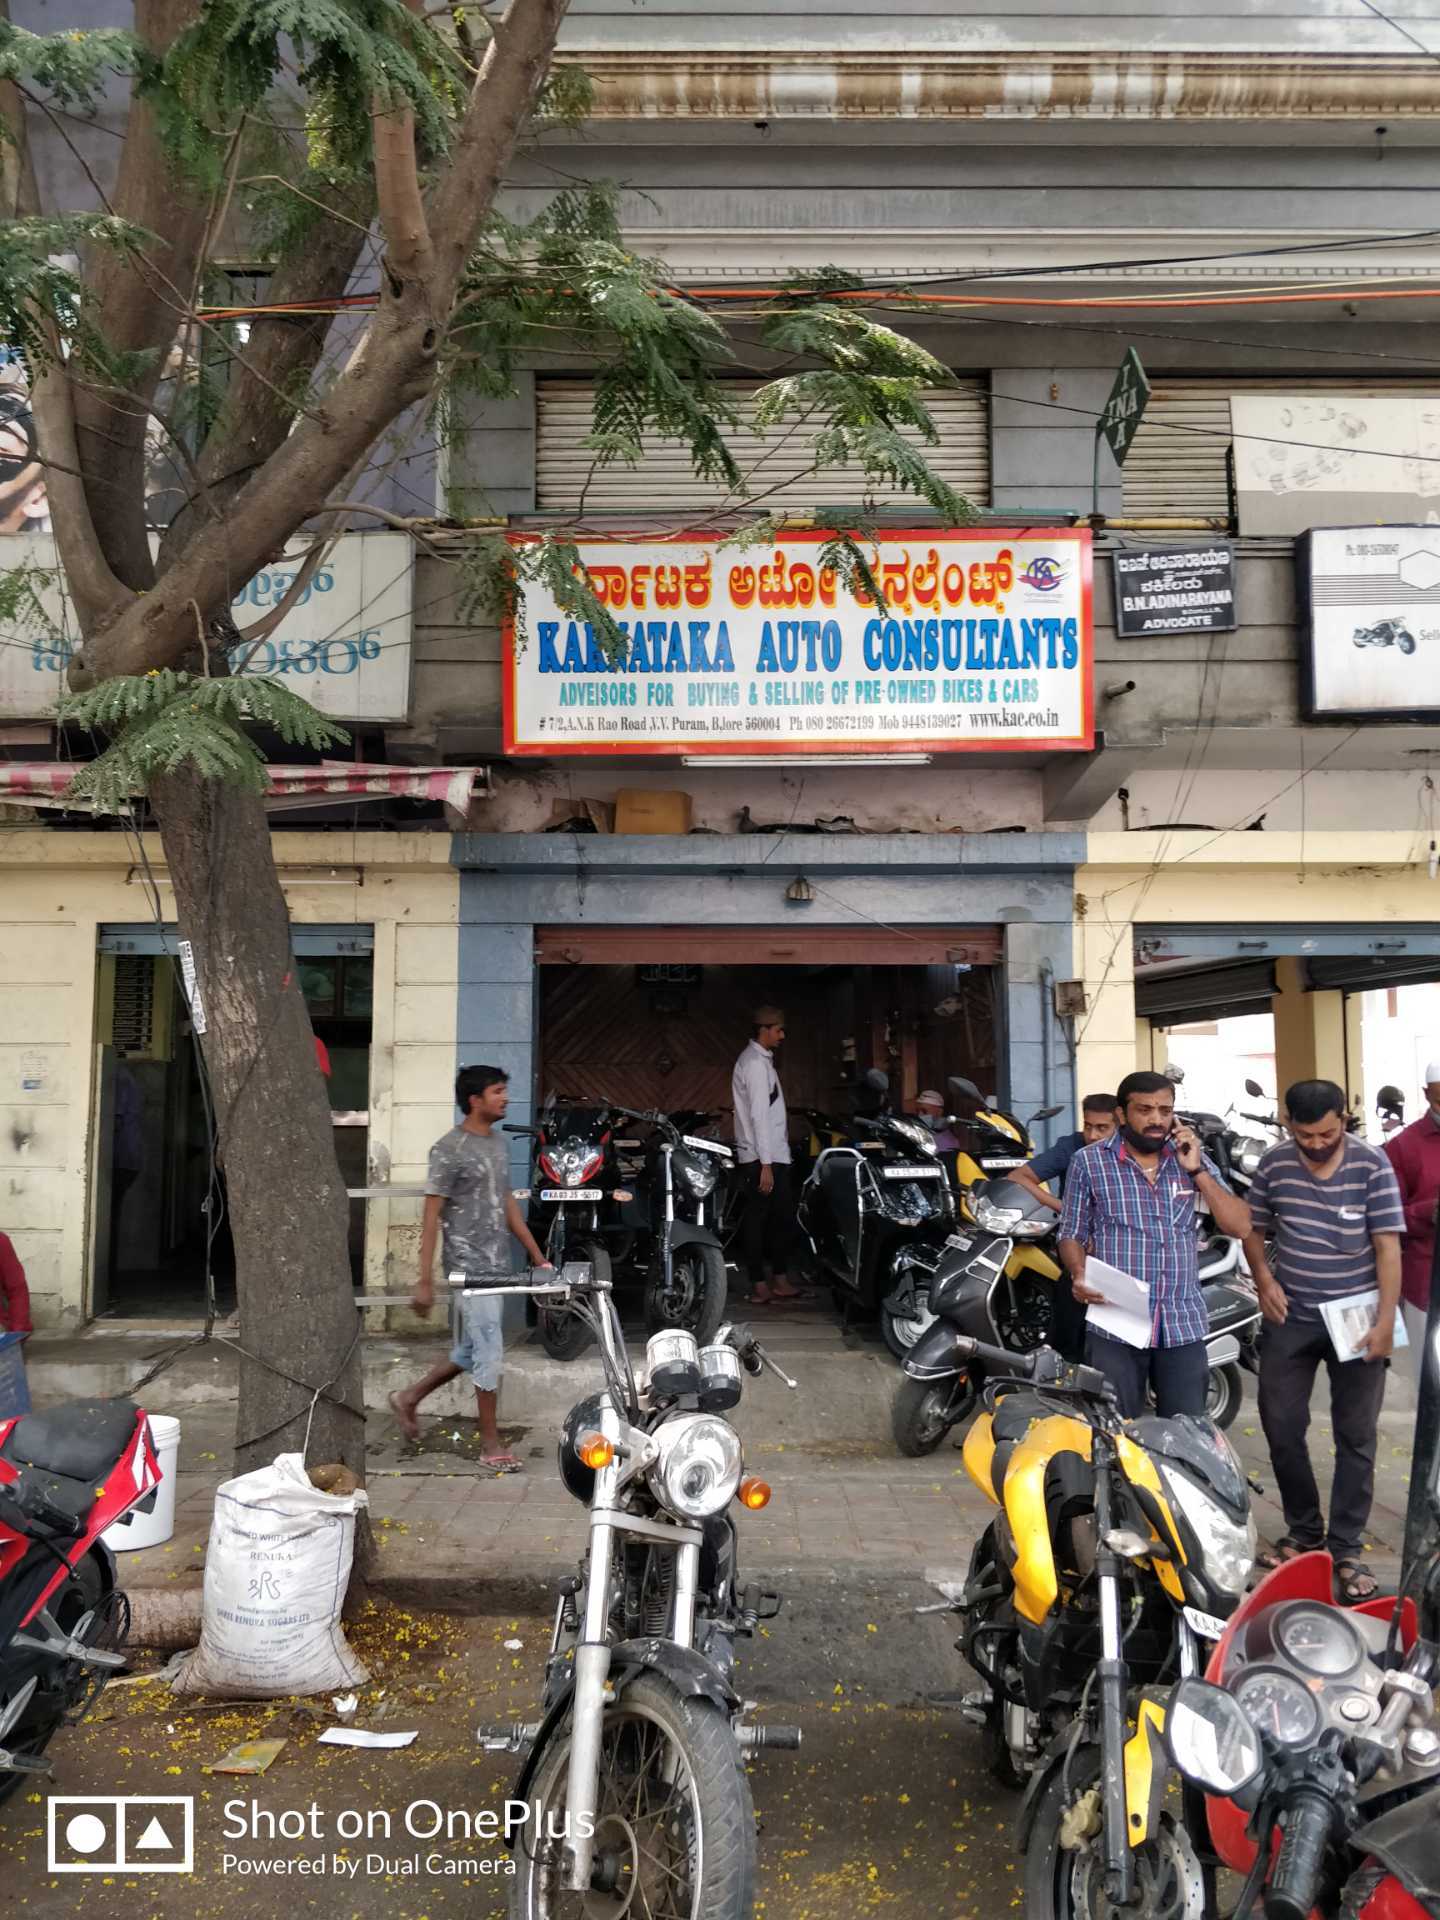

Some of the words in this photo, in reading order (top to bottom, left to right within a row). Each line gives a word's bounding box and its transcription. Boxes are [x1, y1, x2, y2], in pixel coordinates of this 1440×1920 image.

[1143, 615, 1213, 629] ADVOCATE
[756, 620, 842, 672] AUTO
[863, 618, 1078, 671] CONSULTANTS
[559, 682, 637, 706] ADVEISORS
[647, 682, 674, 706] FOR
[688, 682, 740, 706] BUYING
[749, 682, 758, 705] &
[765, 681, 824, 705] SELLING
[831, 681, 849, 704] OF
[942, 679, 983, 703] BIKES
[988, 679, 997, 703] &
[1003, 678, 1039, 703] CARS
[598, 717, 617, 731] Rao
[620, 716, 647, 731] Road
[671, 716, 709, 732] Puram,
[745, 716, 780, 731] 560004
[789, 716, 802, 730] Ph
[826, 715, 874, 730] 26672199
[878, 714, 899, 730] Mob
[969, 707, 1059, 727] www.kac.co.in
